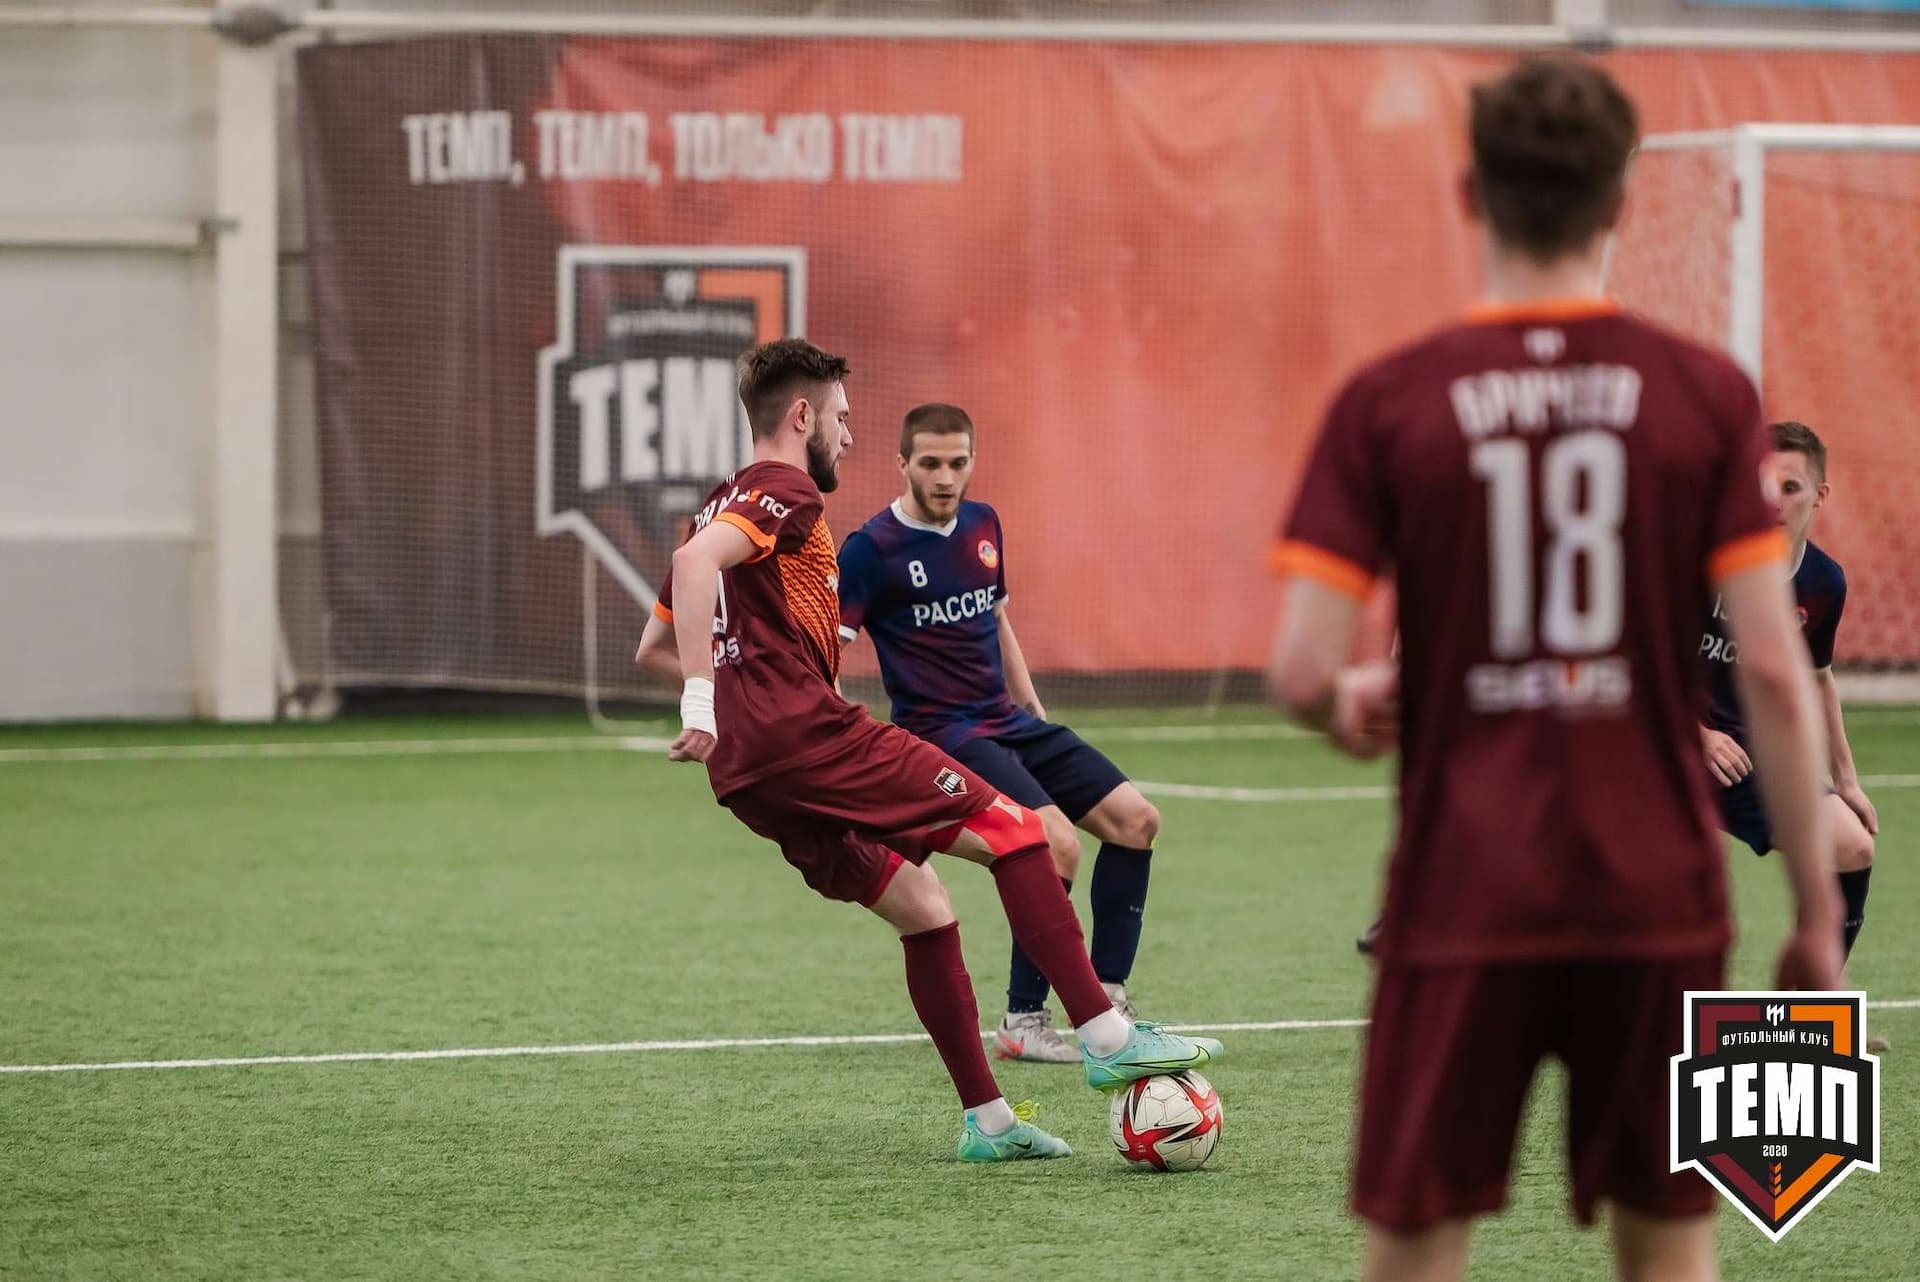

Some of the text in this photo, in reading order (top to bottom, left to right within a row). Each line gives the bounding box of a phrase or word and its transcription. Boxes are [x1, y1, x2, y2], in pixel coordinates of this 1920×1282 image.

[401, 110, 525, 186] ТЕМП,
[533, 110, 661, 186] ТЕМП,
[667, 111, 833, 182] ТОЛЬКО
[569, 356, 754, 492] ТЕМ
[908, 559, 929, 588] 8
[1469, 429, 1628, 660] 18
[1698, 632, 1742, 664] РАС
